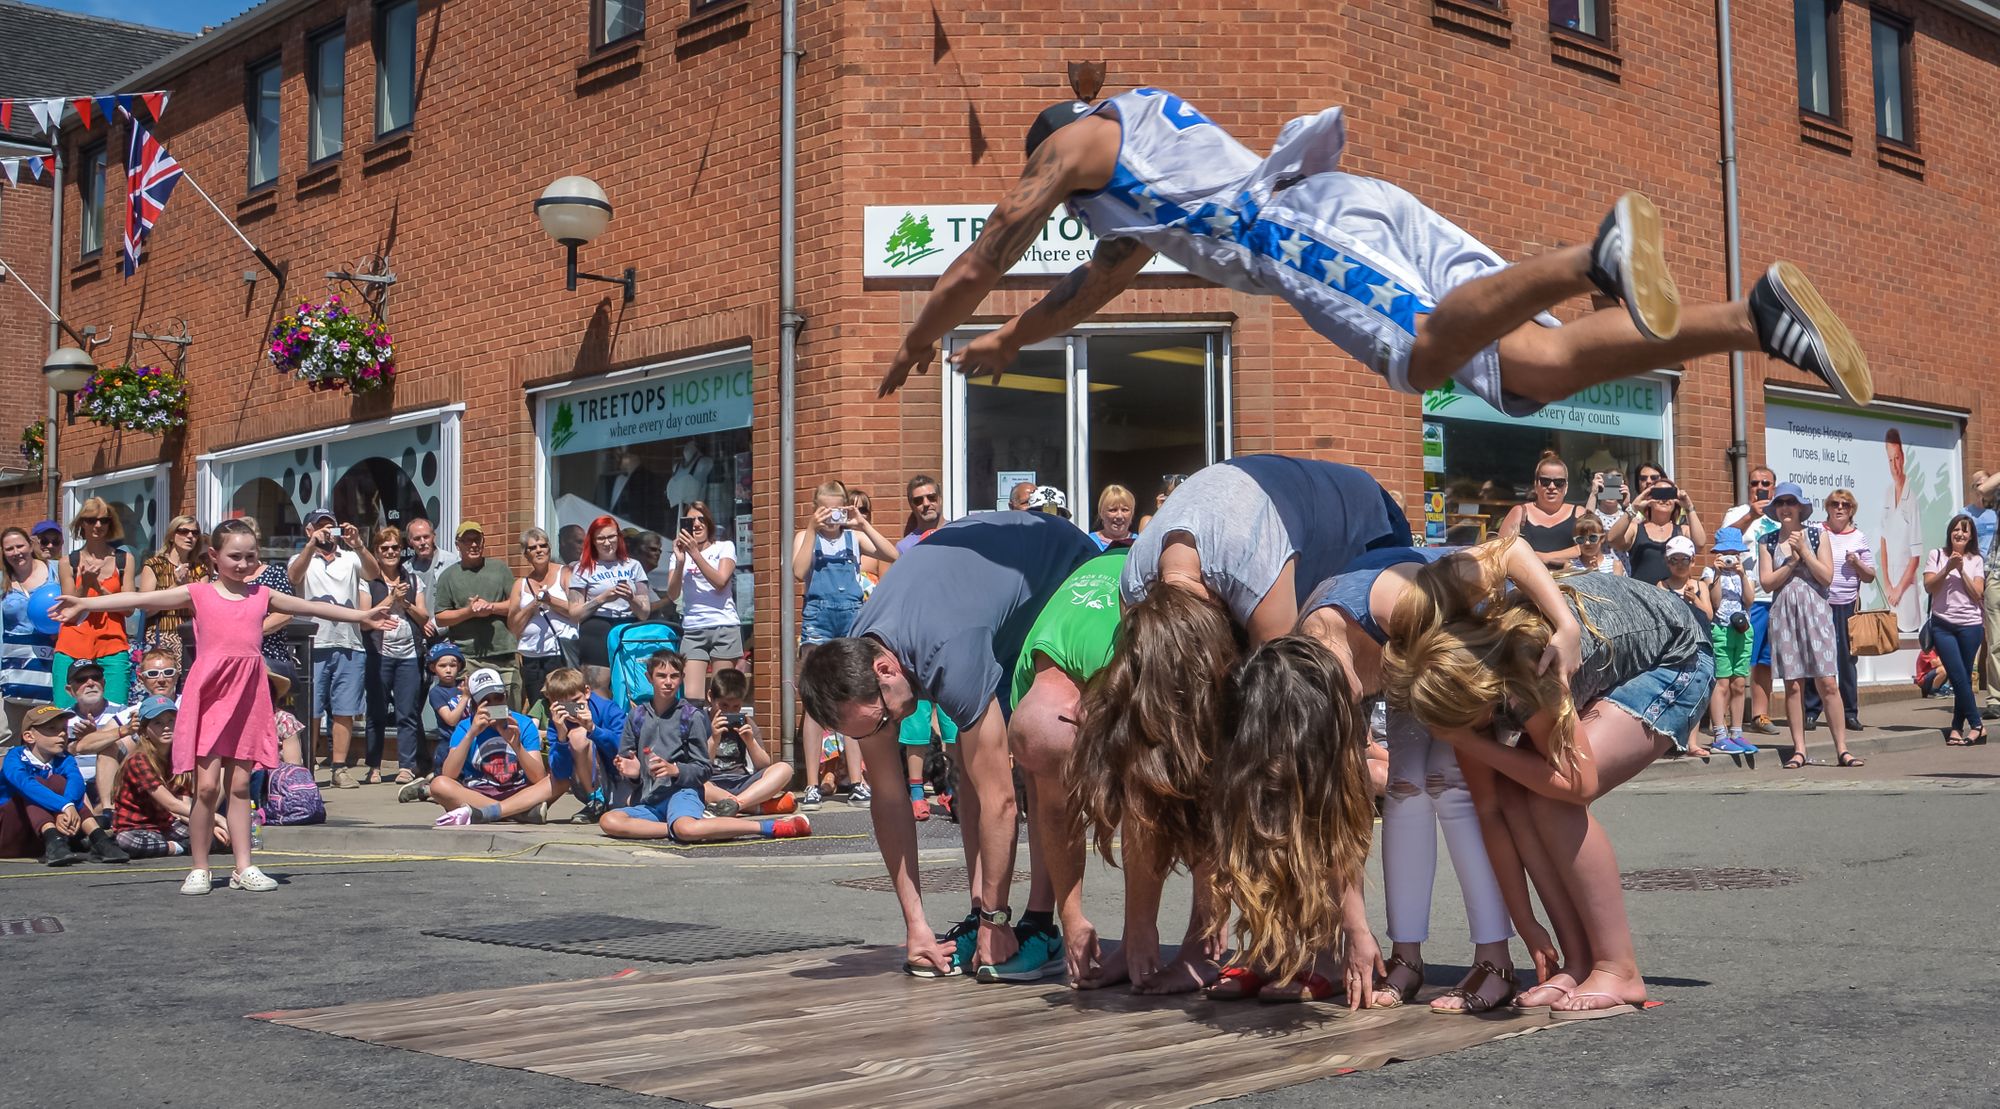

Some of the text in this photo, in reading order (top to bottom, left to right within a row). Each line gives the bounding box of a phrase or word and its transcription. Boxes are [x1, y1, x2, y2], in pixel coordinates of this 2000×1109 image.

[578, 386, 665, 423] TREETOPS
[609, 408, 718, 438] where every day counts
[1538, 406, 1620, 426] every day counts
[1788, 421, 1853, 443] Treetops Hospice
[1792, 447, 1850, 465] nurses, like Liz,
[1789, 470, 1855, 488] provide end of life
[1813, 496, 1820, 508] in
